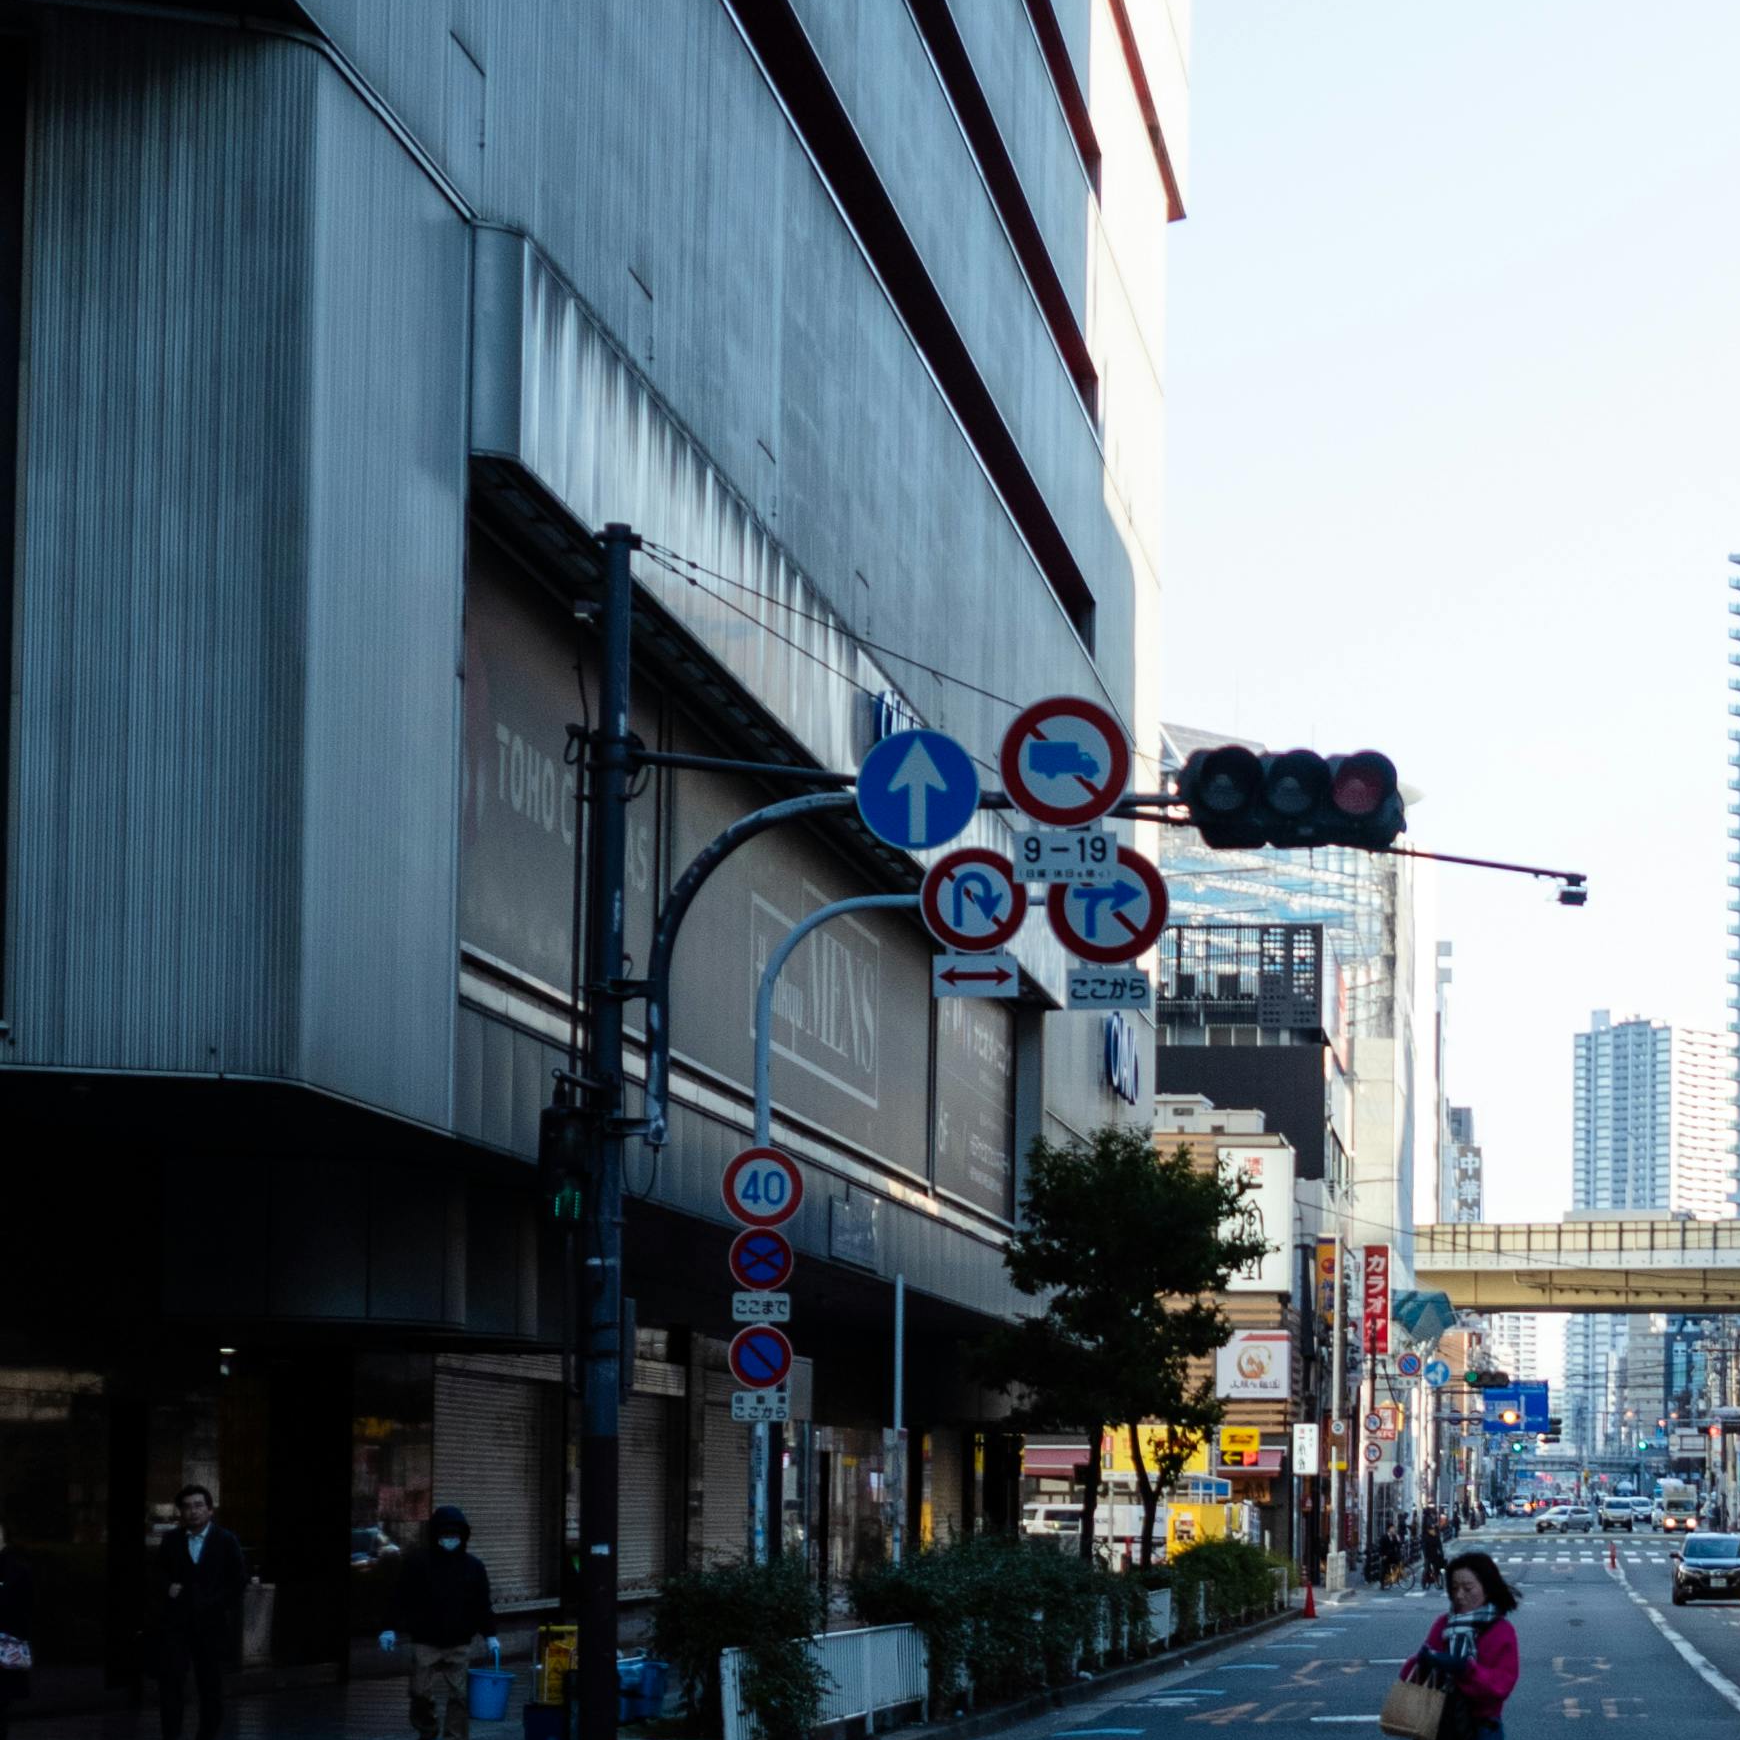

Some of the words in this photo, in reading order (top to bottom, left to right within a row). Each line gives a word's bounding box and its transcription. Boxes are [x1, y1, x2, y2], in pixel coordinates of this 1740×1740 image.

[1071, 979, 1147, 1000] ここから
[740, 1169, 786, 1205] 40
[1366, 1253, 1387, 1337] カラオケ
[735, 1299, 788, 1315] ここまで
[734, 1405, 787, 1419] ここから
